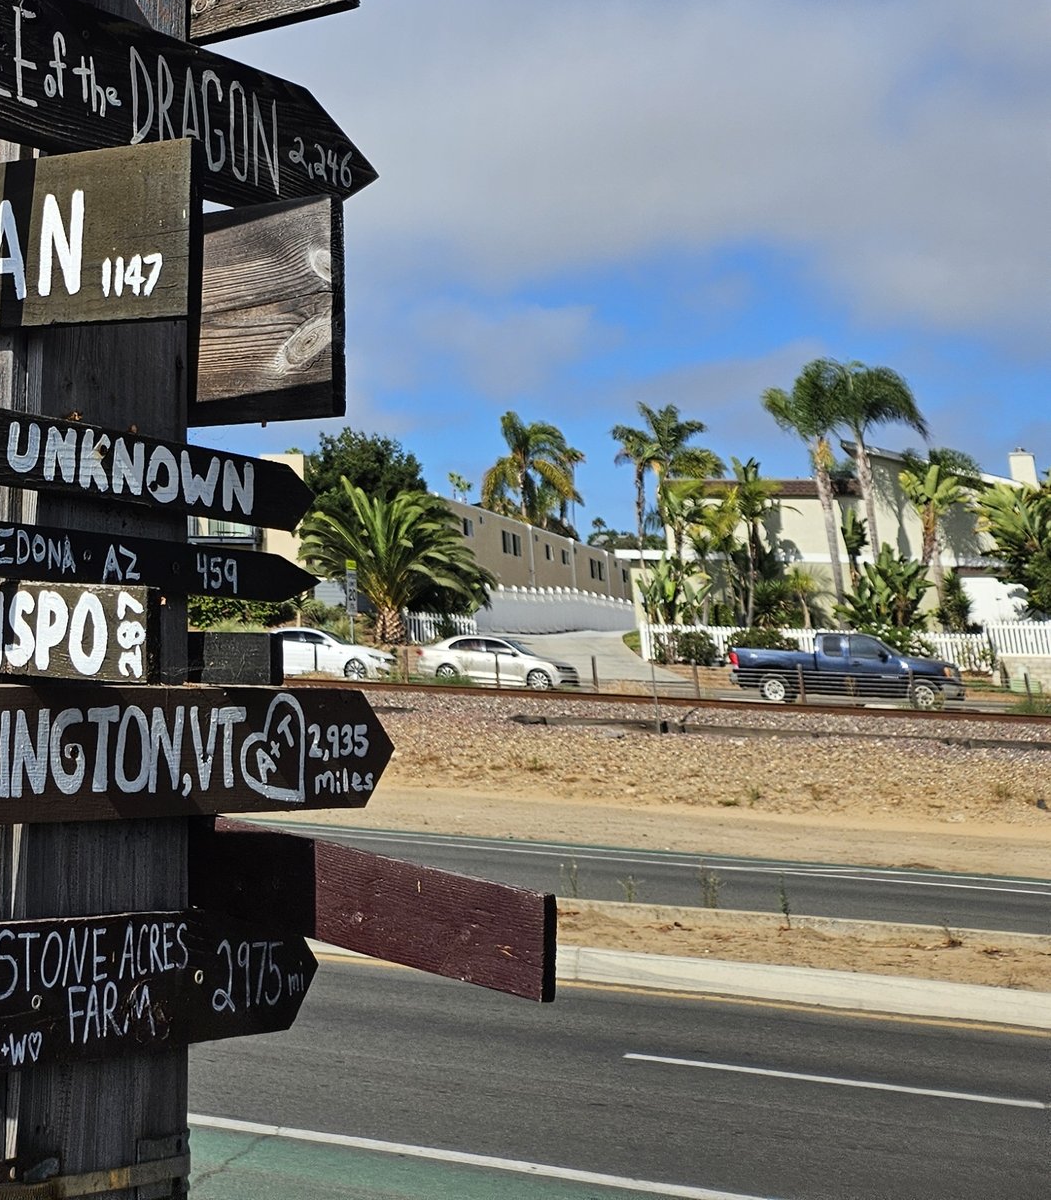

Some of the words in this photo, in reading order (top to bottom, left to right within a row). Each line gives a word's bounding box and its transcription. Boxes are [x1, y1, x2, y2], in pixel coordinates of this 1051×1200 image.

[43, 31, 67, 99] of
[72, 55, 122, 118] the
[129, 45, 280, 196] DRAGON
[101, 253, 163, 298] 1147
[6, 420, 255, 516] UNKNOWN
[101, 543, 142, 584] AZ
[196, 552, 239, 594] 459
[116, 590, 147, 679] 287
[307, 723, 369, 762] 2,935
[118, 920, 188, 980] ACRES
[211, 938, 284, 1013] 2975
[287, 961, 305, 996] mi
[67, 980, 156, 1044] FARM
